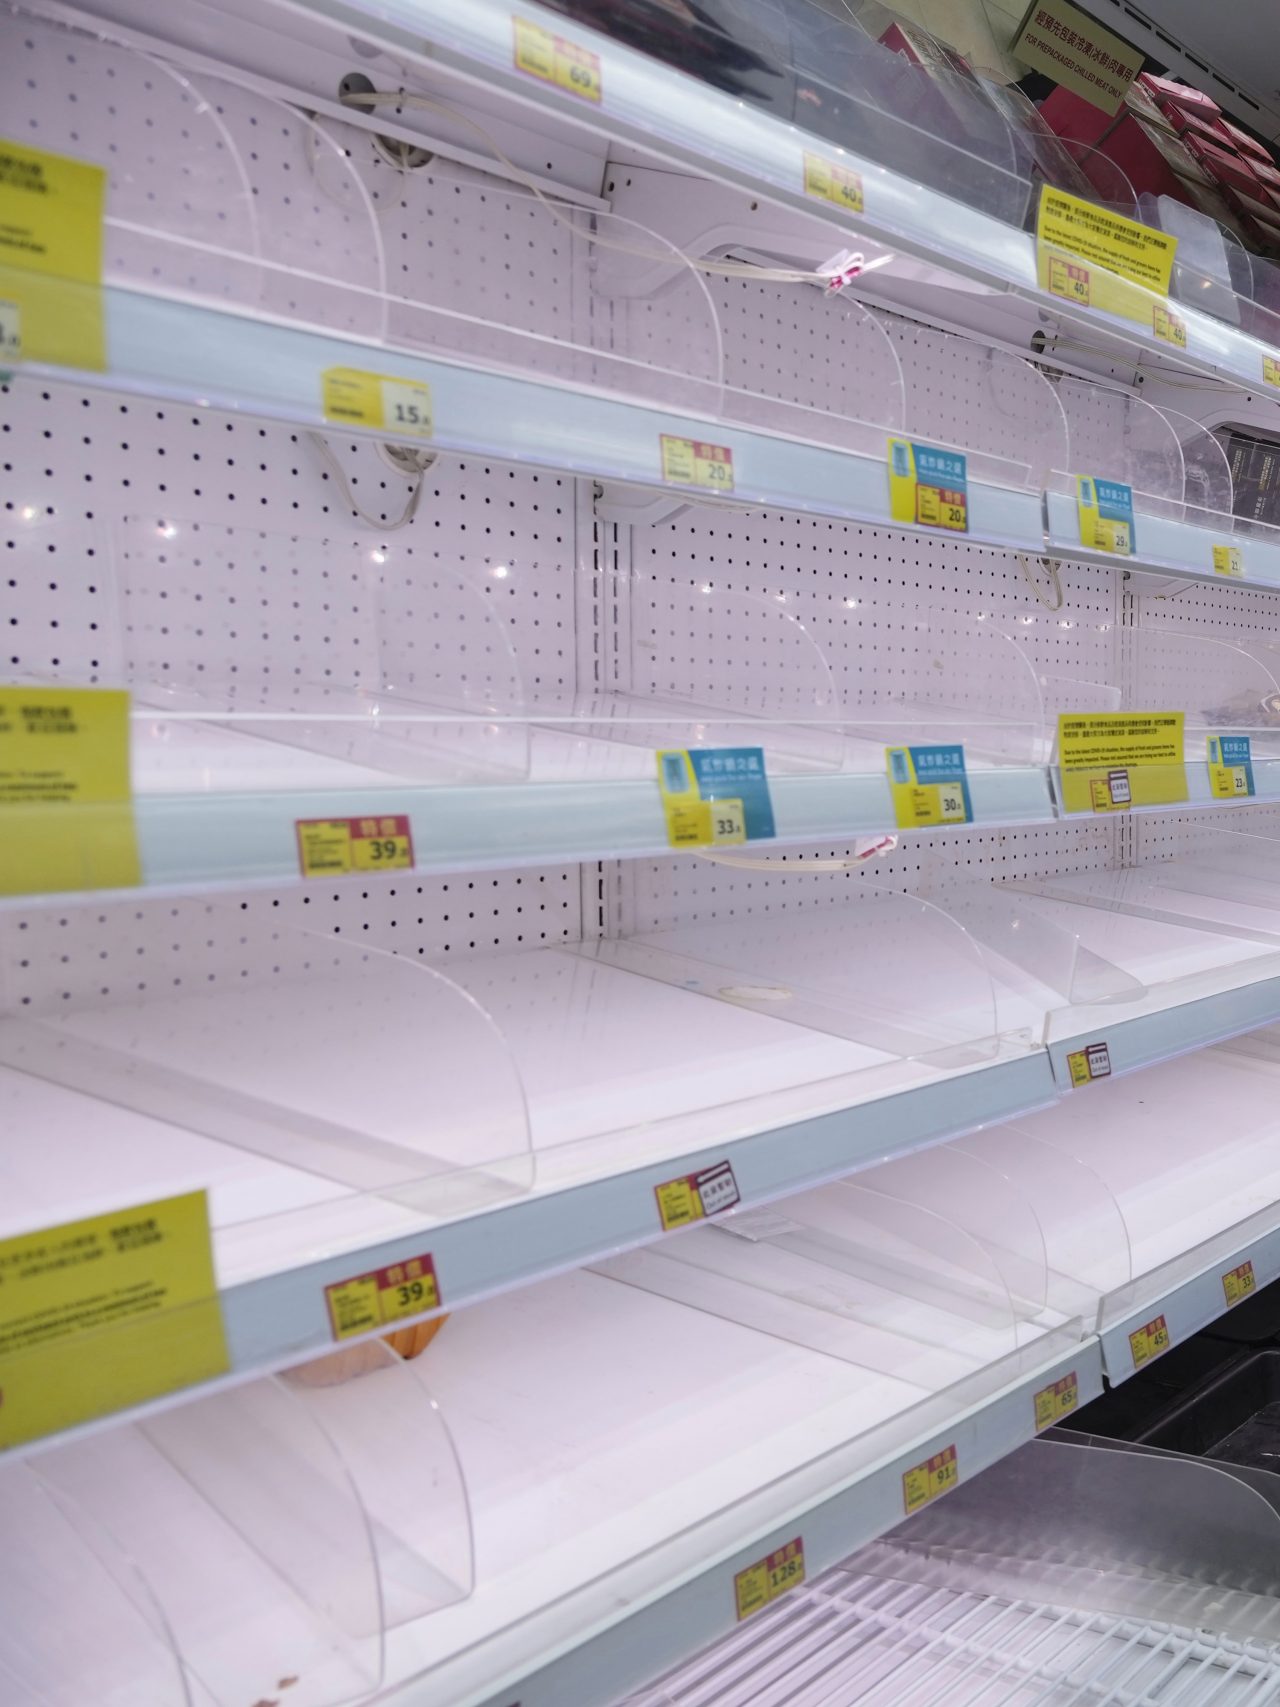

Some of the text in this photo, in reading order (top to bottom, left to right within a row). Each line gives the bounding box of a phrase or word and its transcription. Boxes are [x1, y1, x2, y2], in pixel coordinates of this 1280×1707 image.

[1024, 33, 1122, 98] FOR PREPACKAGED CHILLED MEAT ONLY
